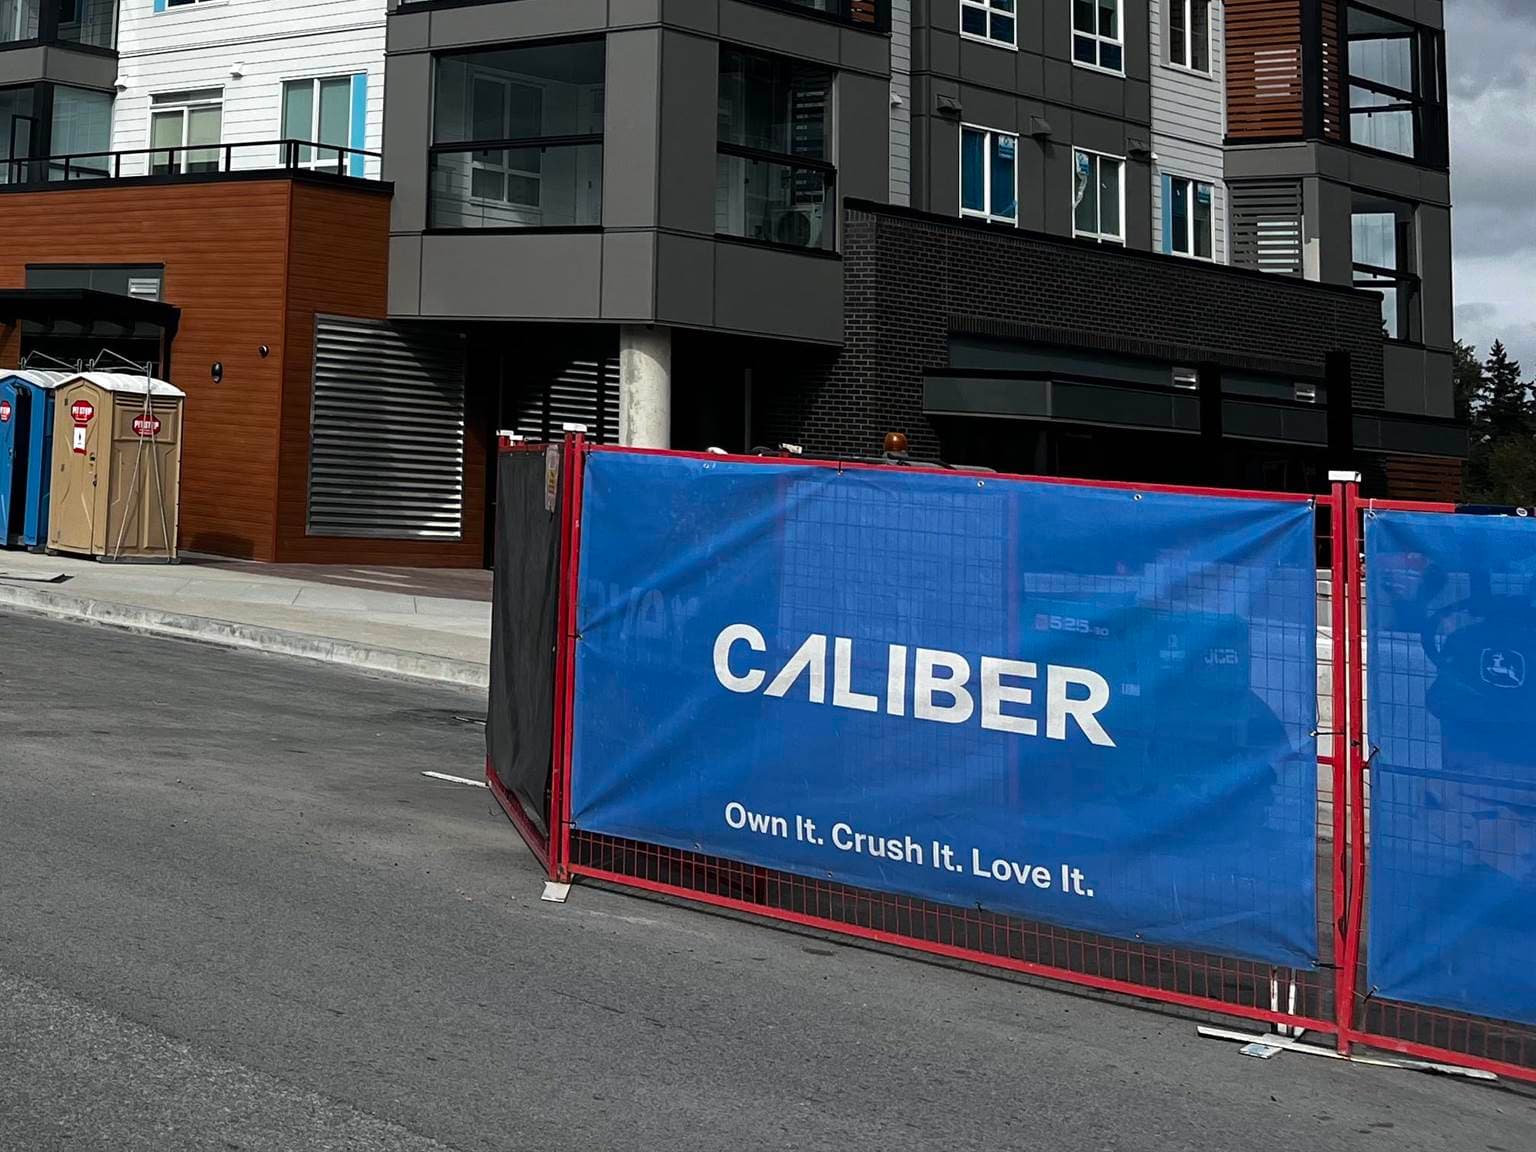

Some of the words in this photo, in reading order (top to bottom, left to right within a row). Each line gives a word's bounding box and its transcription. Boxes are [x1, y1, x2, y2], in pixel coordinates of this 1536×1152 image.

[712, 623, 1117, 747] CALIBER
[724, 801, 788, 837] Own
[796, 814, 824, 846] It.
[831, 822, 923, 865] Crush
[932, 840, 963, 873] It.
[972, 848, 1051, 889] Love
[1061, 864, 1095, 898] It.
